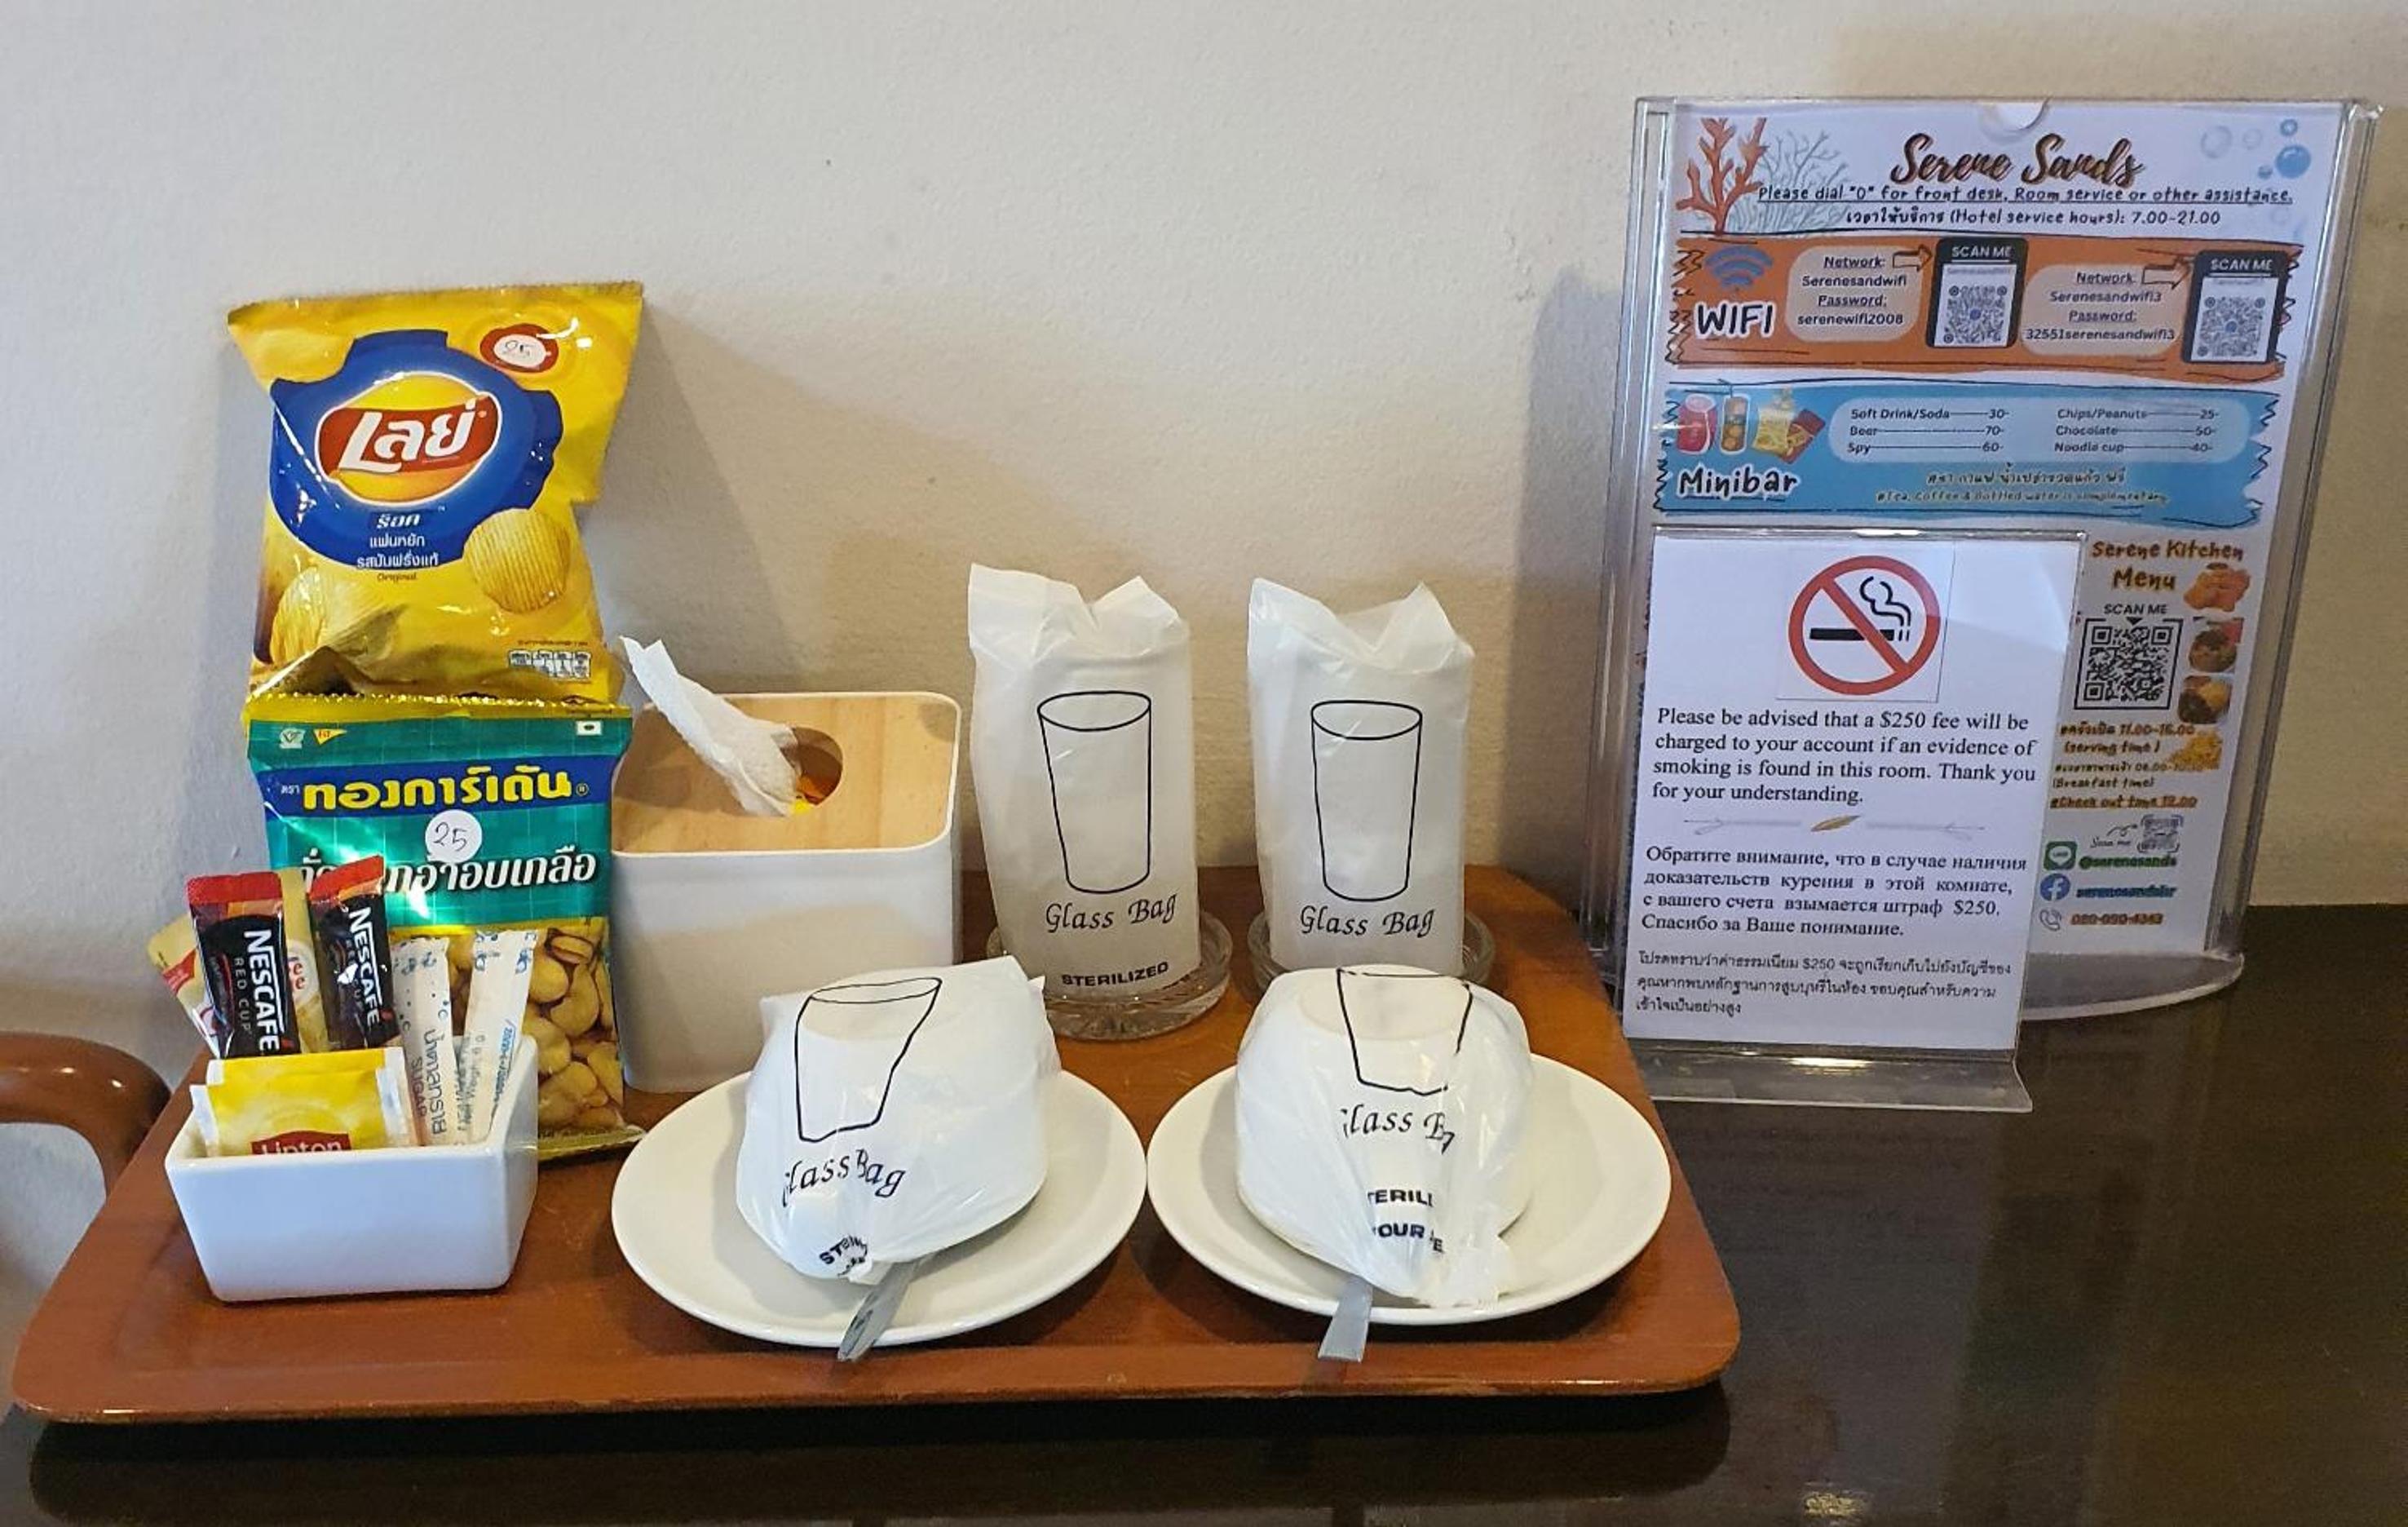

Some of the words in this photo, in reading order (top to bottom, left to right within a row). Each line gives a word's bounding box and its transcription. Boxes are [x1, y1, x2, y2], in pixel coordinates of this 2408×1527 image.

[1890, 132, 2013, 185] Serene
[2021, 132, 2146, 189] Sands
[1758, 185, 1809, 201] Please
[1814, 186, 1845, 201] dial
[1849, 186, 1874, 200] "0"
[1881, 186, 1909, 200] for
[1915, 186, 1960, 202] front
[2014, 187, 2061, 202] Room
[2066, 188, 2124, 201] service
[2128, 190, 2148, 201] or
[2152, 187, 2200, 202] other
[1845, 205, 1945, 224] เวลาให้บริการ
[1950, 207, 2002, 224] (Hotel
[2006, 210, 2064, 224] service
[2069, 210, 2126, 225] hours):
[2131, 210, 2221, 226] 7.00-21.00
[1823, 255, 1887, 270] Network:
[1951, 246, 1990, 259] SCAN
[1993, 246, 2013, 259] ME
[2210, 258, 2251, 271] SCAN
[2255, 259, 2273, 271] ME
[1801, 275, 1907, 288] Serenesandwifi
[1817, 294, 1888, 308] Password:
[2049, 291, 2163, 303] Serenesandwifi3
[1696, 303, 1775, 336] WIFI
[1797, 313, 1904, 326] serenewifi2008
[2068, 310, 2138, 323] Password:
[2025, 329, 2175, 341] 32551serenesandwifi3
[1850, 408, 1877, 420] Soft
[1879, 408, 1951, 420] Drink/Soda
[2057, 409, 2148, 420] Chips/Peanuts
[337, 398, 479, 474] เลย์
[1850, 426, 1877, 436] Beer
[2055, 425, 2119, 436] Chocolate
[1847, 441, 1871, 454] Spy
[2054, 442, 2099, 453] Noodle
[2101, 443, 2125, 455] cup
[1677, 469, 1798, 497] Minibar
[2092, 540, 2161, 560] Serene
[2166, 539, 2244, 561] Kitchen
[2112, 567, 2176, 590] Menu
[2104, 604, 2145, 615] SCAN
[2148, 604, 2168, 615] ME
[1657, 707, 1716, 725] Please
[1721, 708, 1743, 725] be
[1747, 709, 1818, 727] advised
[1823, 710, 1858, 728] that
[1864, 715, 1875, 728] a
[1880, 710, 1926, 729] $250
[1931, 712, 1960, 729] fee
[1966, 712, 2001, 730] will
[2007, 713, 2029, 730] be
[1655, 733, 1726, 754] charged
[1732, 737, 1750, 750] to
[1754, 739, 1798, 755] your
[1803, 738, 1874, 753] account
[1880, 736, 1898, 753] if
[1899, 741, 1921, 754] an
[1927, 737, 2008, 755] evidence
[2013, 740, 2039, 755] of
[1653, 758, 1731, 779] smoking
[1737, 759, 1752, 775] is
[1759, 759, 1810, 777] found
[1816, 760, 1834, 777] in
[1840, 760, 1873, 777] this
[1878, 765, 1931, 779] room.
[1938, 762, 1995, 781] Thank
[1999, 768, 2036, 785] you
[1652, 781, 1679, 799] for
[1682, 786, 1726, 803] your
[1730, 785, 1864, 807] understanding.
[433, 821, 468, 852] 25
[1646, 845, 1732, 865] Обратите
[1736, 851, 1830, 867] внимание,
[1836, 855, 1865, 866] что
[1871, 856, 1881, 866] в
[1886, 856, 1947, 871] случае
[1952, 857, 2027, 870] наличия
[1643, 872, 1770, 887] доказательств
[1781, 875, 1853, 892] курения
[1864, 879, 1875, 889] в
[1885, 875, 1925, 891] этой
[1936, 879, 2013, 896] комнате,
[1045, 901, 1115, 934] Glass
[1128, 893, 1177, 924] Bag
[1643, 895, 1653, 906] с
[1657, 896, 1721, 909] вашего
[1725, 896, 1774, 910] счета
[1784, 898, 1877, 913] взымается
[1883, 899, 1943, 918] штраф
[1952, 900, 2000, 916] $250.
[1299, 905, 1370, 936] Glass
[1381, 908, 1436, 938] Bag
[1641, 914, 1719, 931] Спасибо
[1722, 919, 1741, 931] за
[1747, 916, 1796, 932] Ваше
[1800, 923, 1905, 936] понимание.
[1638, 949, 1799, 969] โปรดทราบว่าค่าธรรมเนียม
[1802, 957, 1836, 970] $250
[233, 957, 248, 990] RED
[1062, 961, 1169, 987] STERILIZED
[1870, 981, 1996, 999] ขอบคุณสำหรับความ
[236, 994, 252, 1033] CUP
[1636, 997, 1742, 1018] เข้าใจเป็นอย่างสูง
[409, 1056, 428, 1117] SUGAR
[1340, 1103, 1415, 1139] lass
[782, 1154, 851, 1207] lass
[856, 1149, 907, 1198] Bag
[1372, 1222, 1426, 1240] OUR
